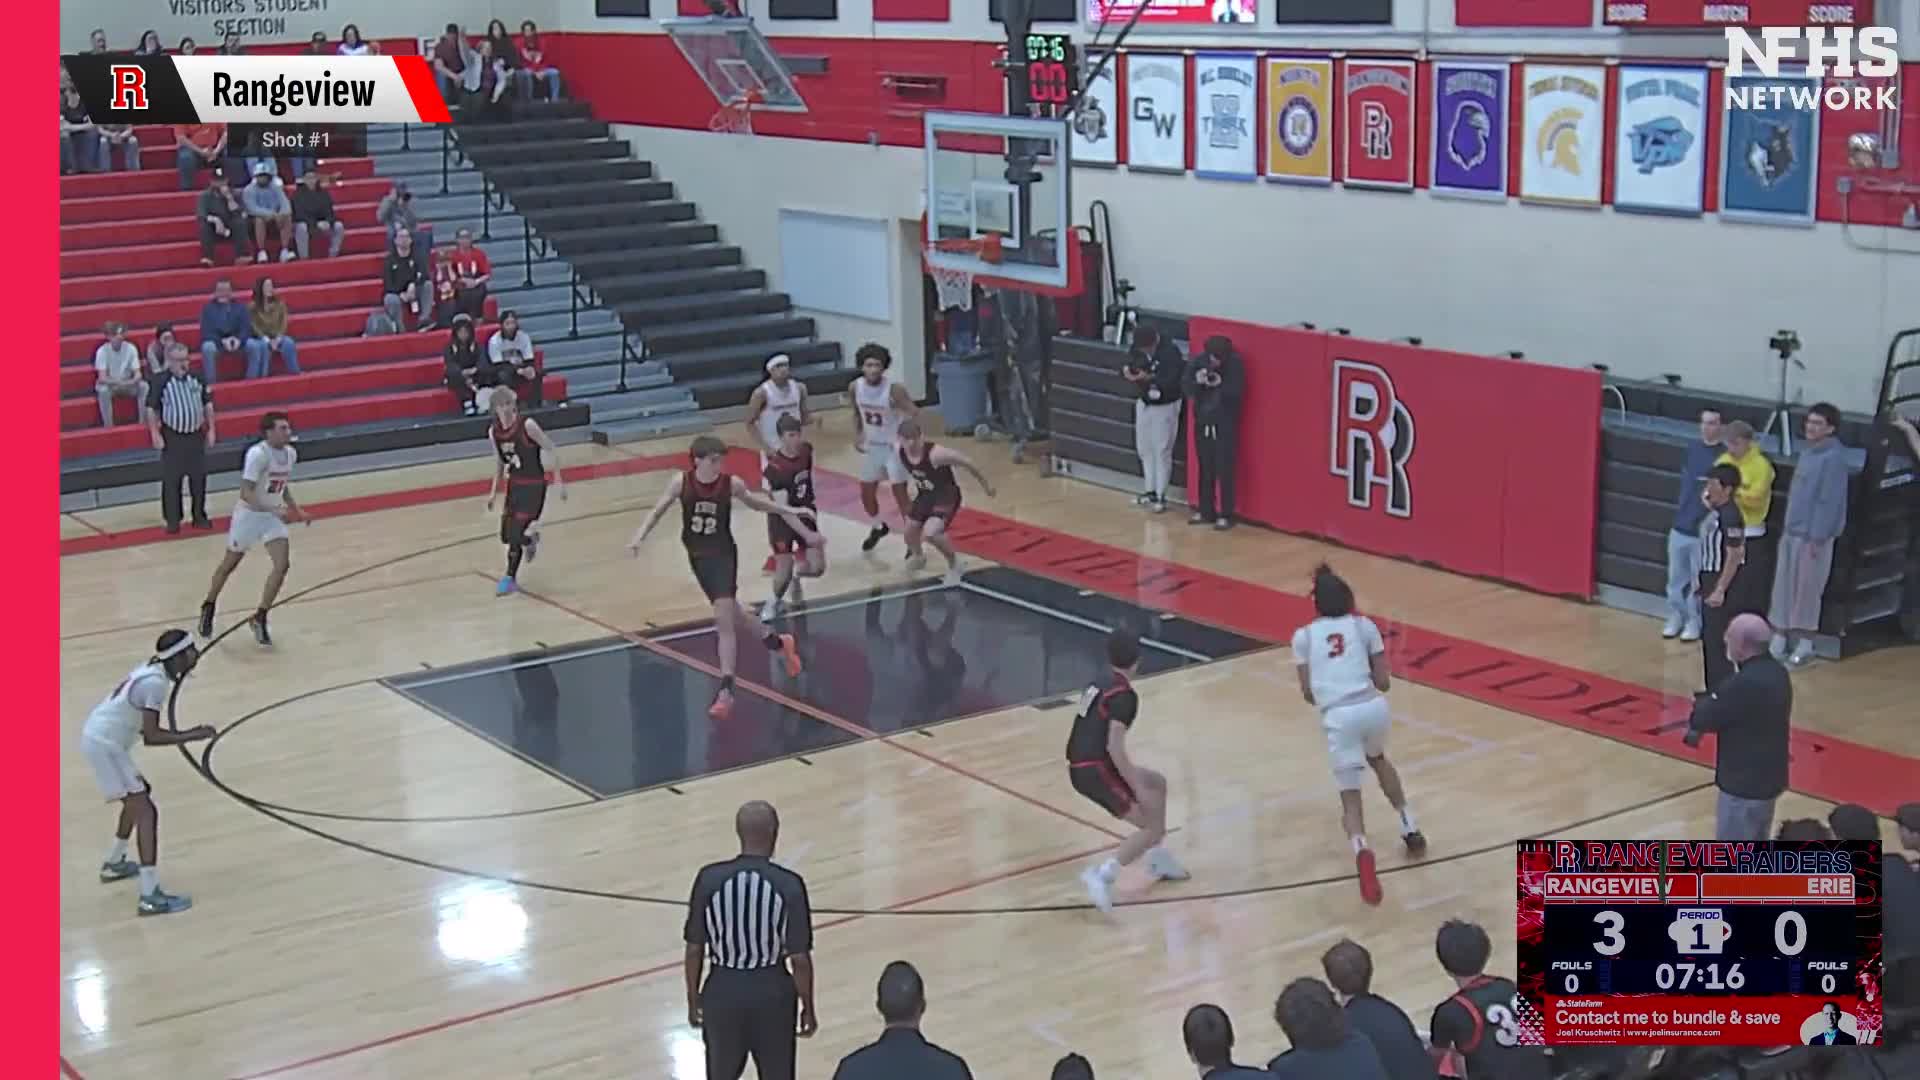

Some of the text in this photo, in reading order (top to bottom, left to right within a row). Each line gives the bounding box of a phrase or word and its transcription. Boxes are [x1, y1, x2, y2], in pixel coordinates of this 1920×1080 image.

[169, 0, 328, 14] VISITORS STUDENT
[1808, 5, 1853, 23] SCORE
[213, 18, 286, 36] SECTION
[1133, 97, 1177, 139] GW
[1326, 633, 1346, 659] 3
[1486, 995, 1518, 1047] 3
